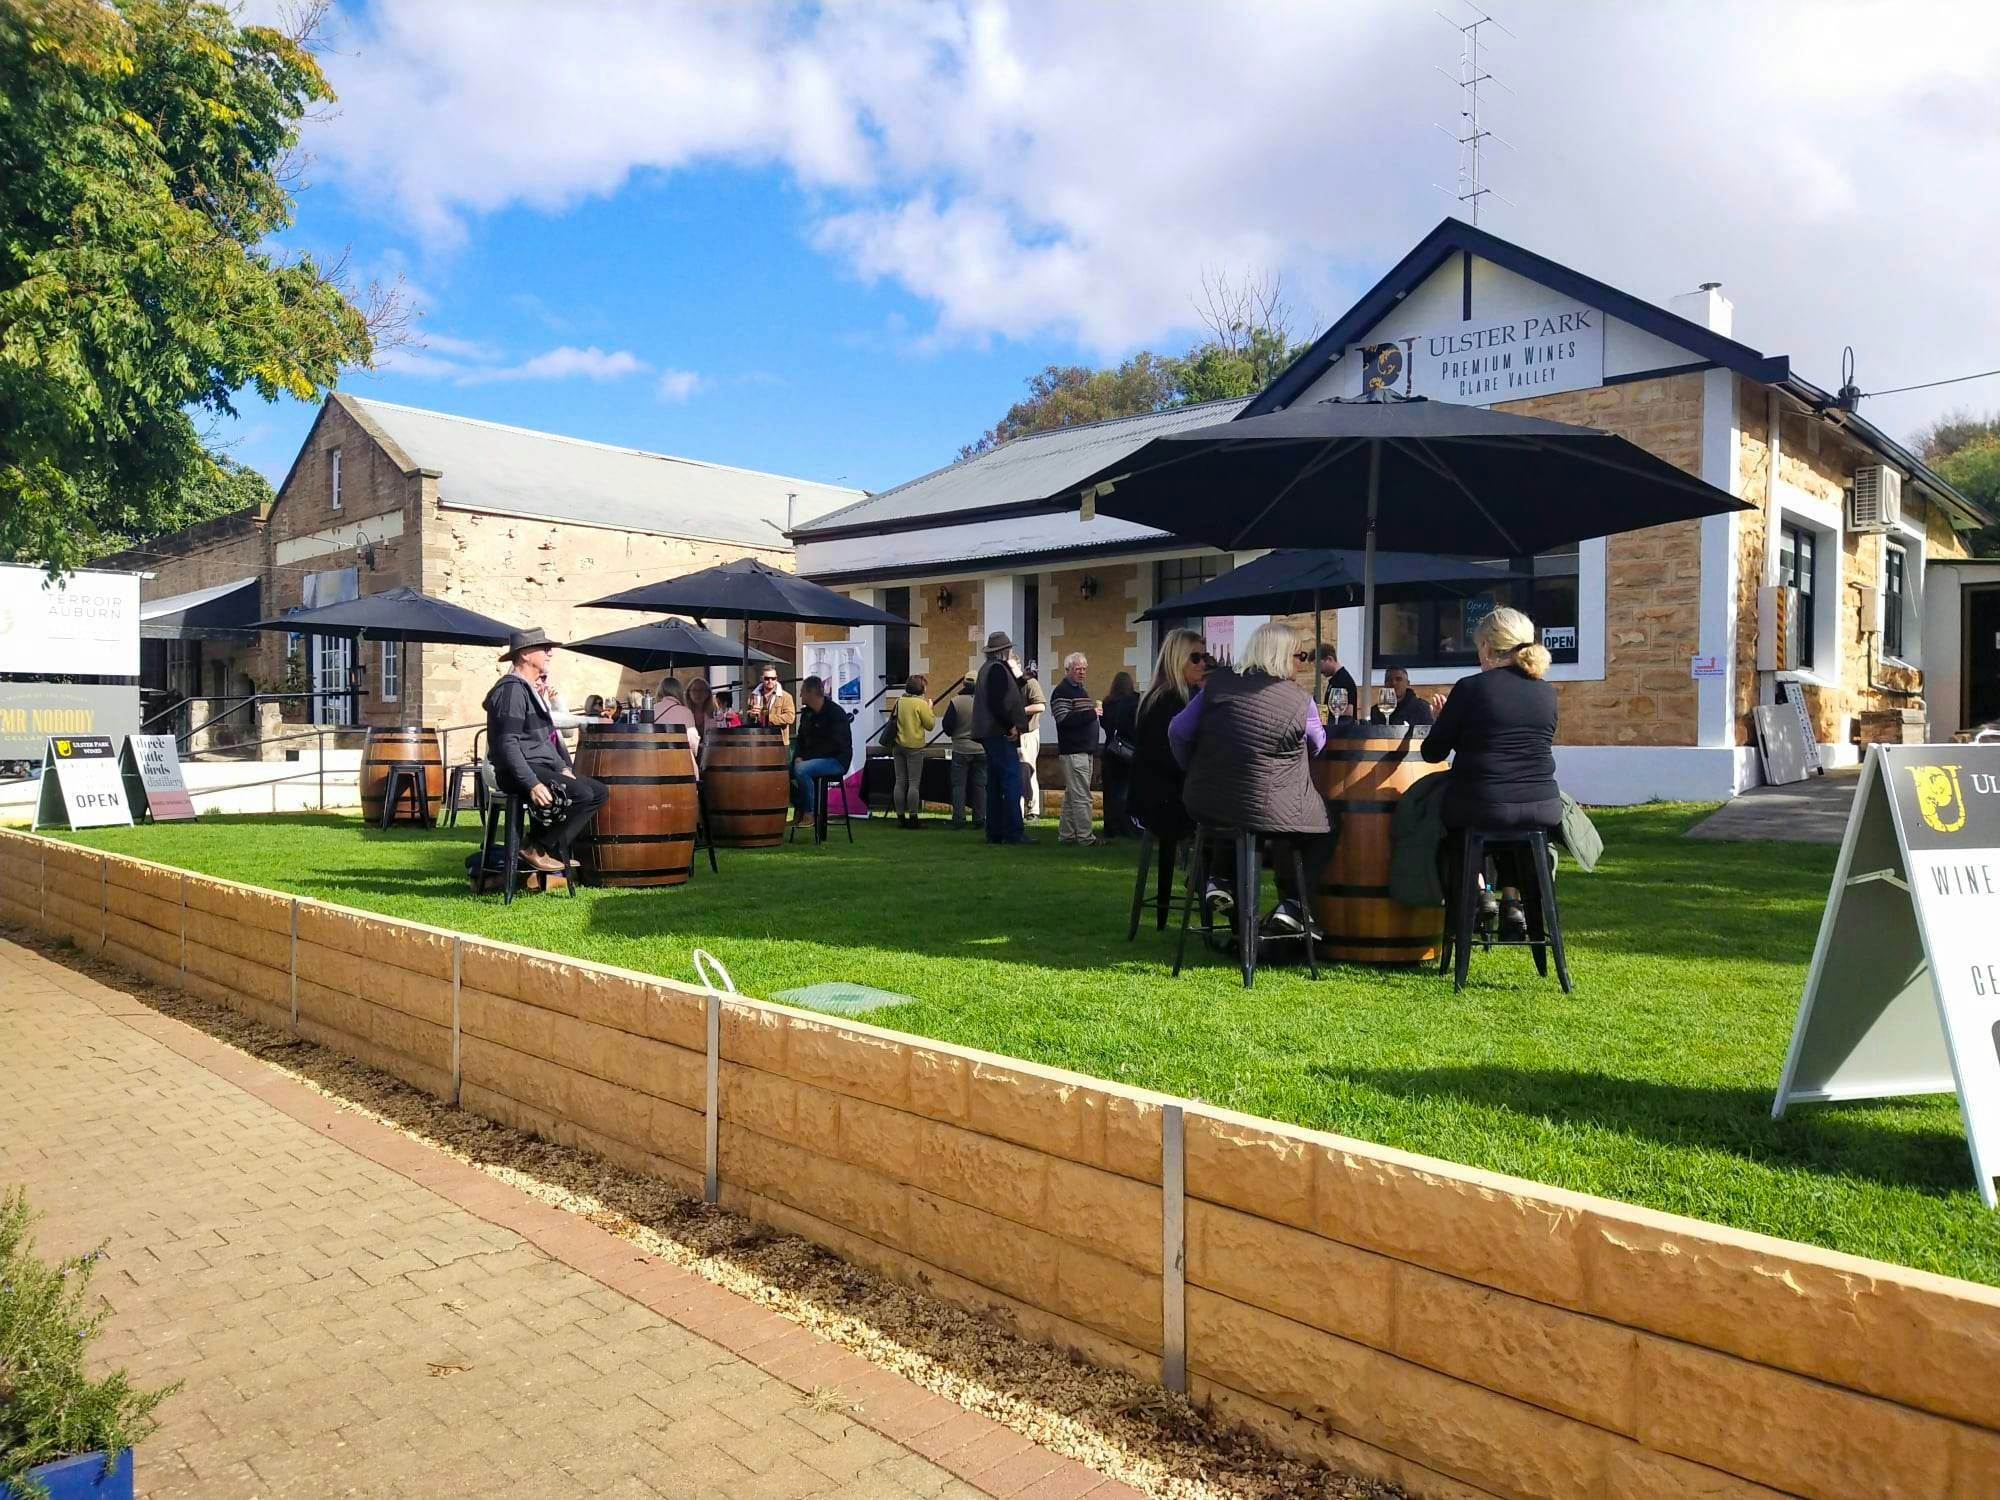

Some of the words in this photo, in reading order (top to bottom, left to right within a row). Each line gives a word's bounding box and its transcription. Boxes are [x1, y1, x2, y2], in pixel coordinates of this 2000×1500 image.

[1428, 326, 1517, 357] ULSTER
[1522, 310, 1593, 339] PARK
[1441, 353, 1512, 380] PREMIUM
[1523, 340, 1576, 365] WINES
[1459, 370, 1498, 396] CLARE
[1508, 367, 1556, 389] VALLEY
[48, 593, 122, 608] TERROIR
[48, 606, 121, 620] AUBURN
[1544, 636, 1574, 648] OPEN
[32, 707, 94, 733] NOBODY
[143, 763, 170, 775] birds
[76, 793, 119, 808] OPEN
